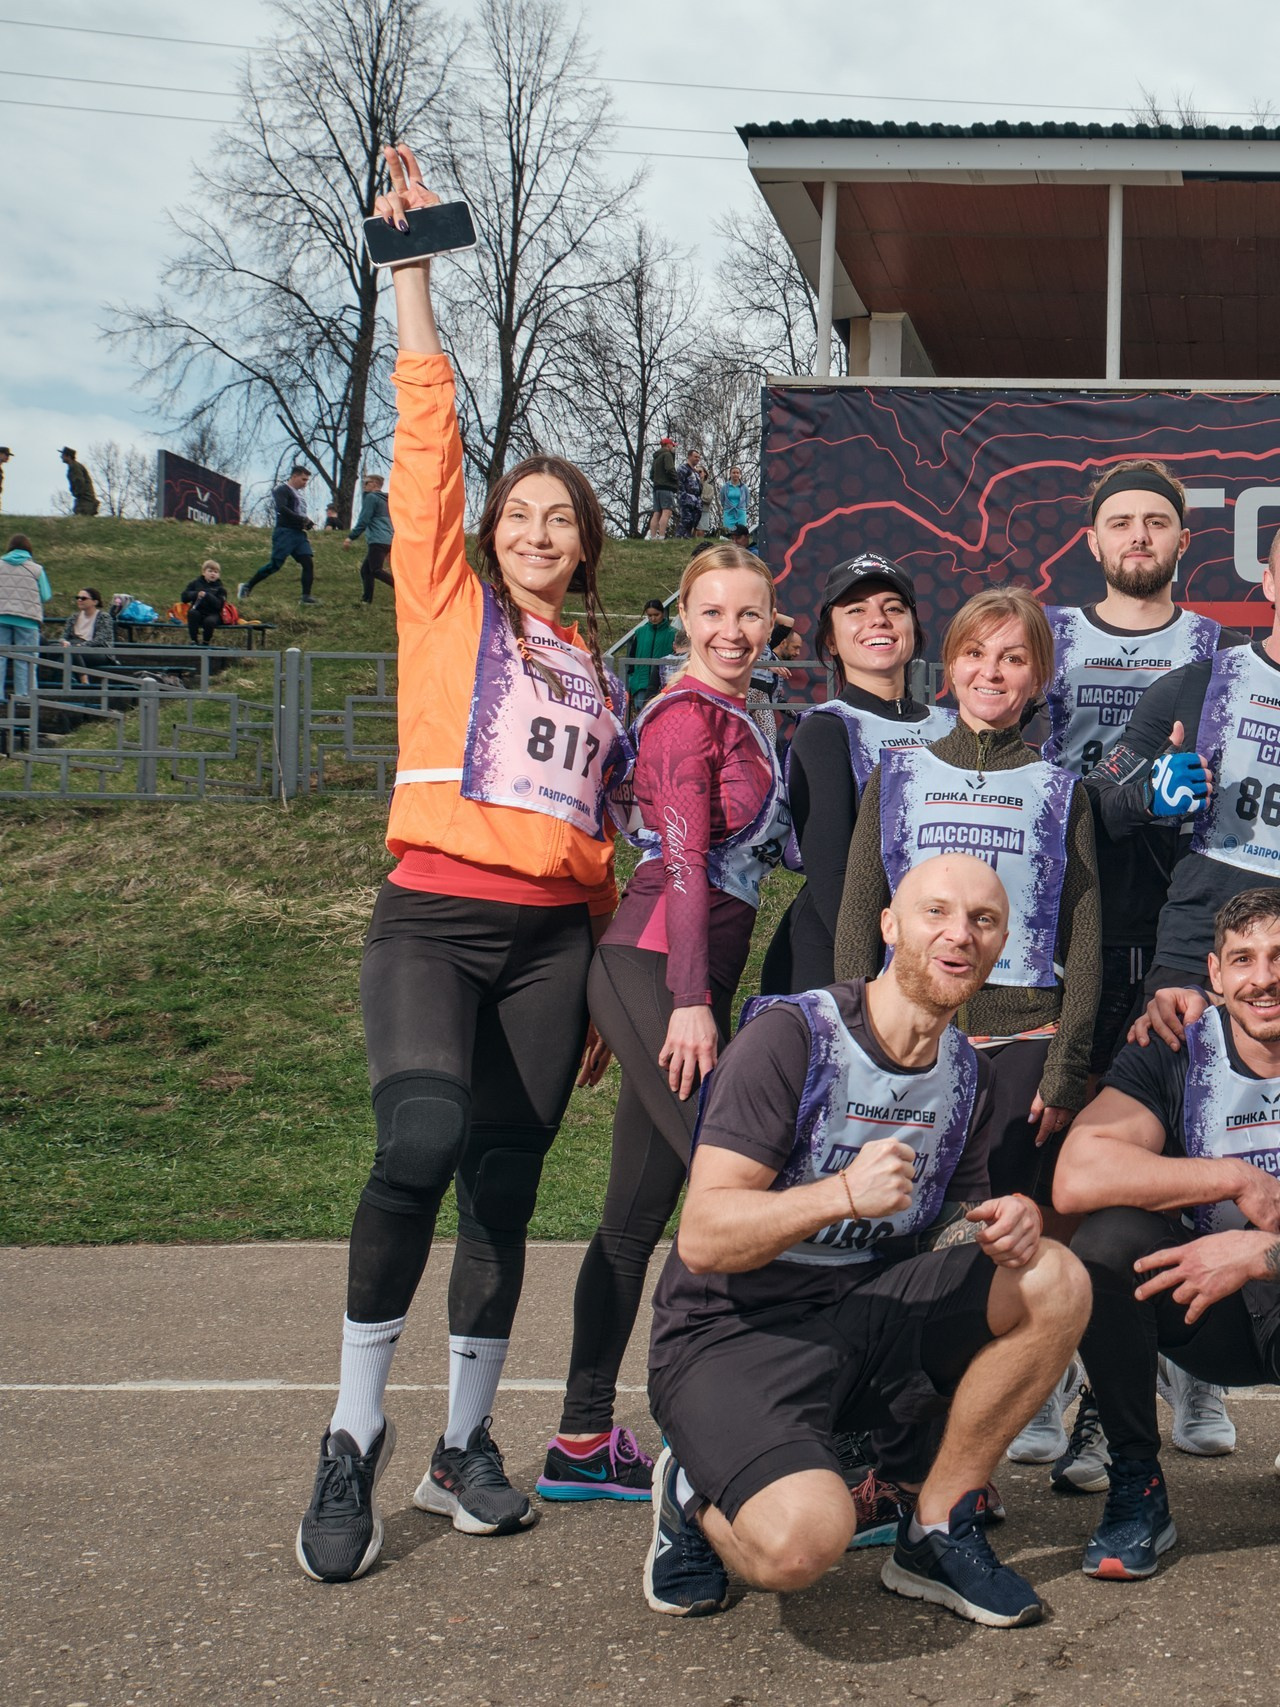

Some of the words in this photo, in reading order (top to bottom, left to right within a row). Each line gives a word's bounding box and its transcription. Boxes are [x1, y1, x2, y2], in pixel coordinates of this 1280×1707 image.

[1084, 657, 1124, 667] ГОНКА
[1126, 659, 1172, 667] ГЕРОЕВ
[1101, 707, 1134, 725] СТА
[527, 716, 600, 778] 817
[881, 737, 919, 748] ГОНКА
[924, 792, 968, 802] ГОНКА
[973, 793, 1024, 807] ГЕРОЕВ
[920, 825, 1021, 850] МАССОВЫЙ
[846, 1101, 890, 1120] ГОНКА
[891, 1108, 936, 1124] ГЕРОЕВ
[1226, 1111, 1267, 1127] ГОНКА
